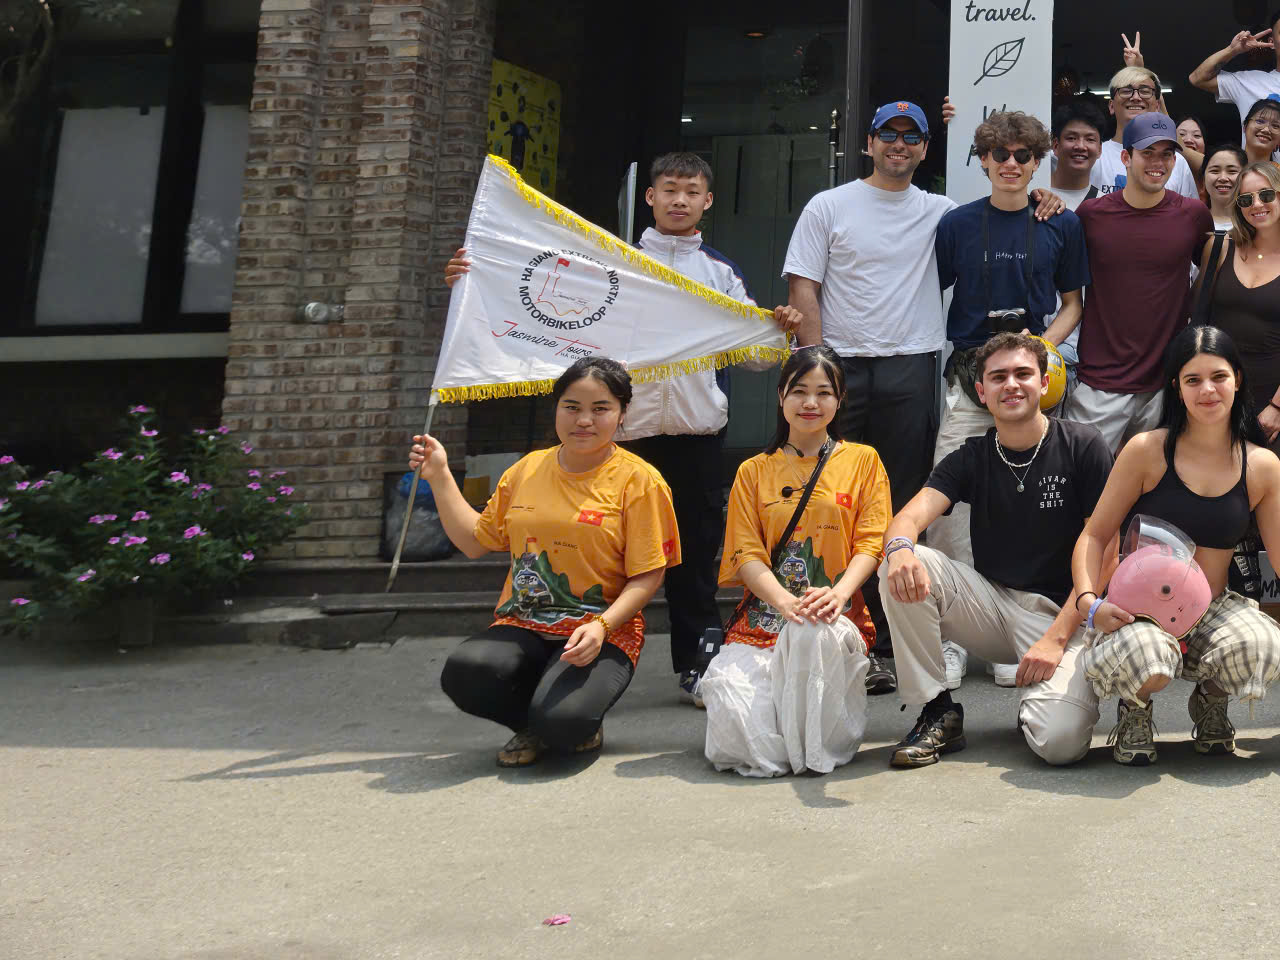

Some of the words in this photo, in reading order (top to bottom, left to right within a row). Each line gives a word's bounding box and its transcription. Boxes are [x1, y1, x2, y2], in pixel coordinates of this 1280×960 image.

[606, 269, 620, 305] NORTH
[518, 285, 608, 331] MOTORBIKELOOP
[491, 320, 559, 348] Jasmine
[554, 336, 601, 357] Tours
[1042, 491, 1061, 500] THE
[1047, 483, 1056, 491] IS
[1039, 499, 1064, 509] SHIT
